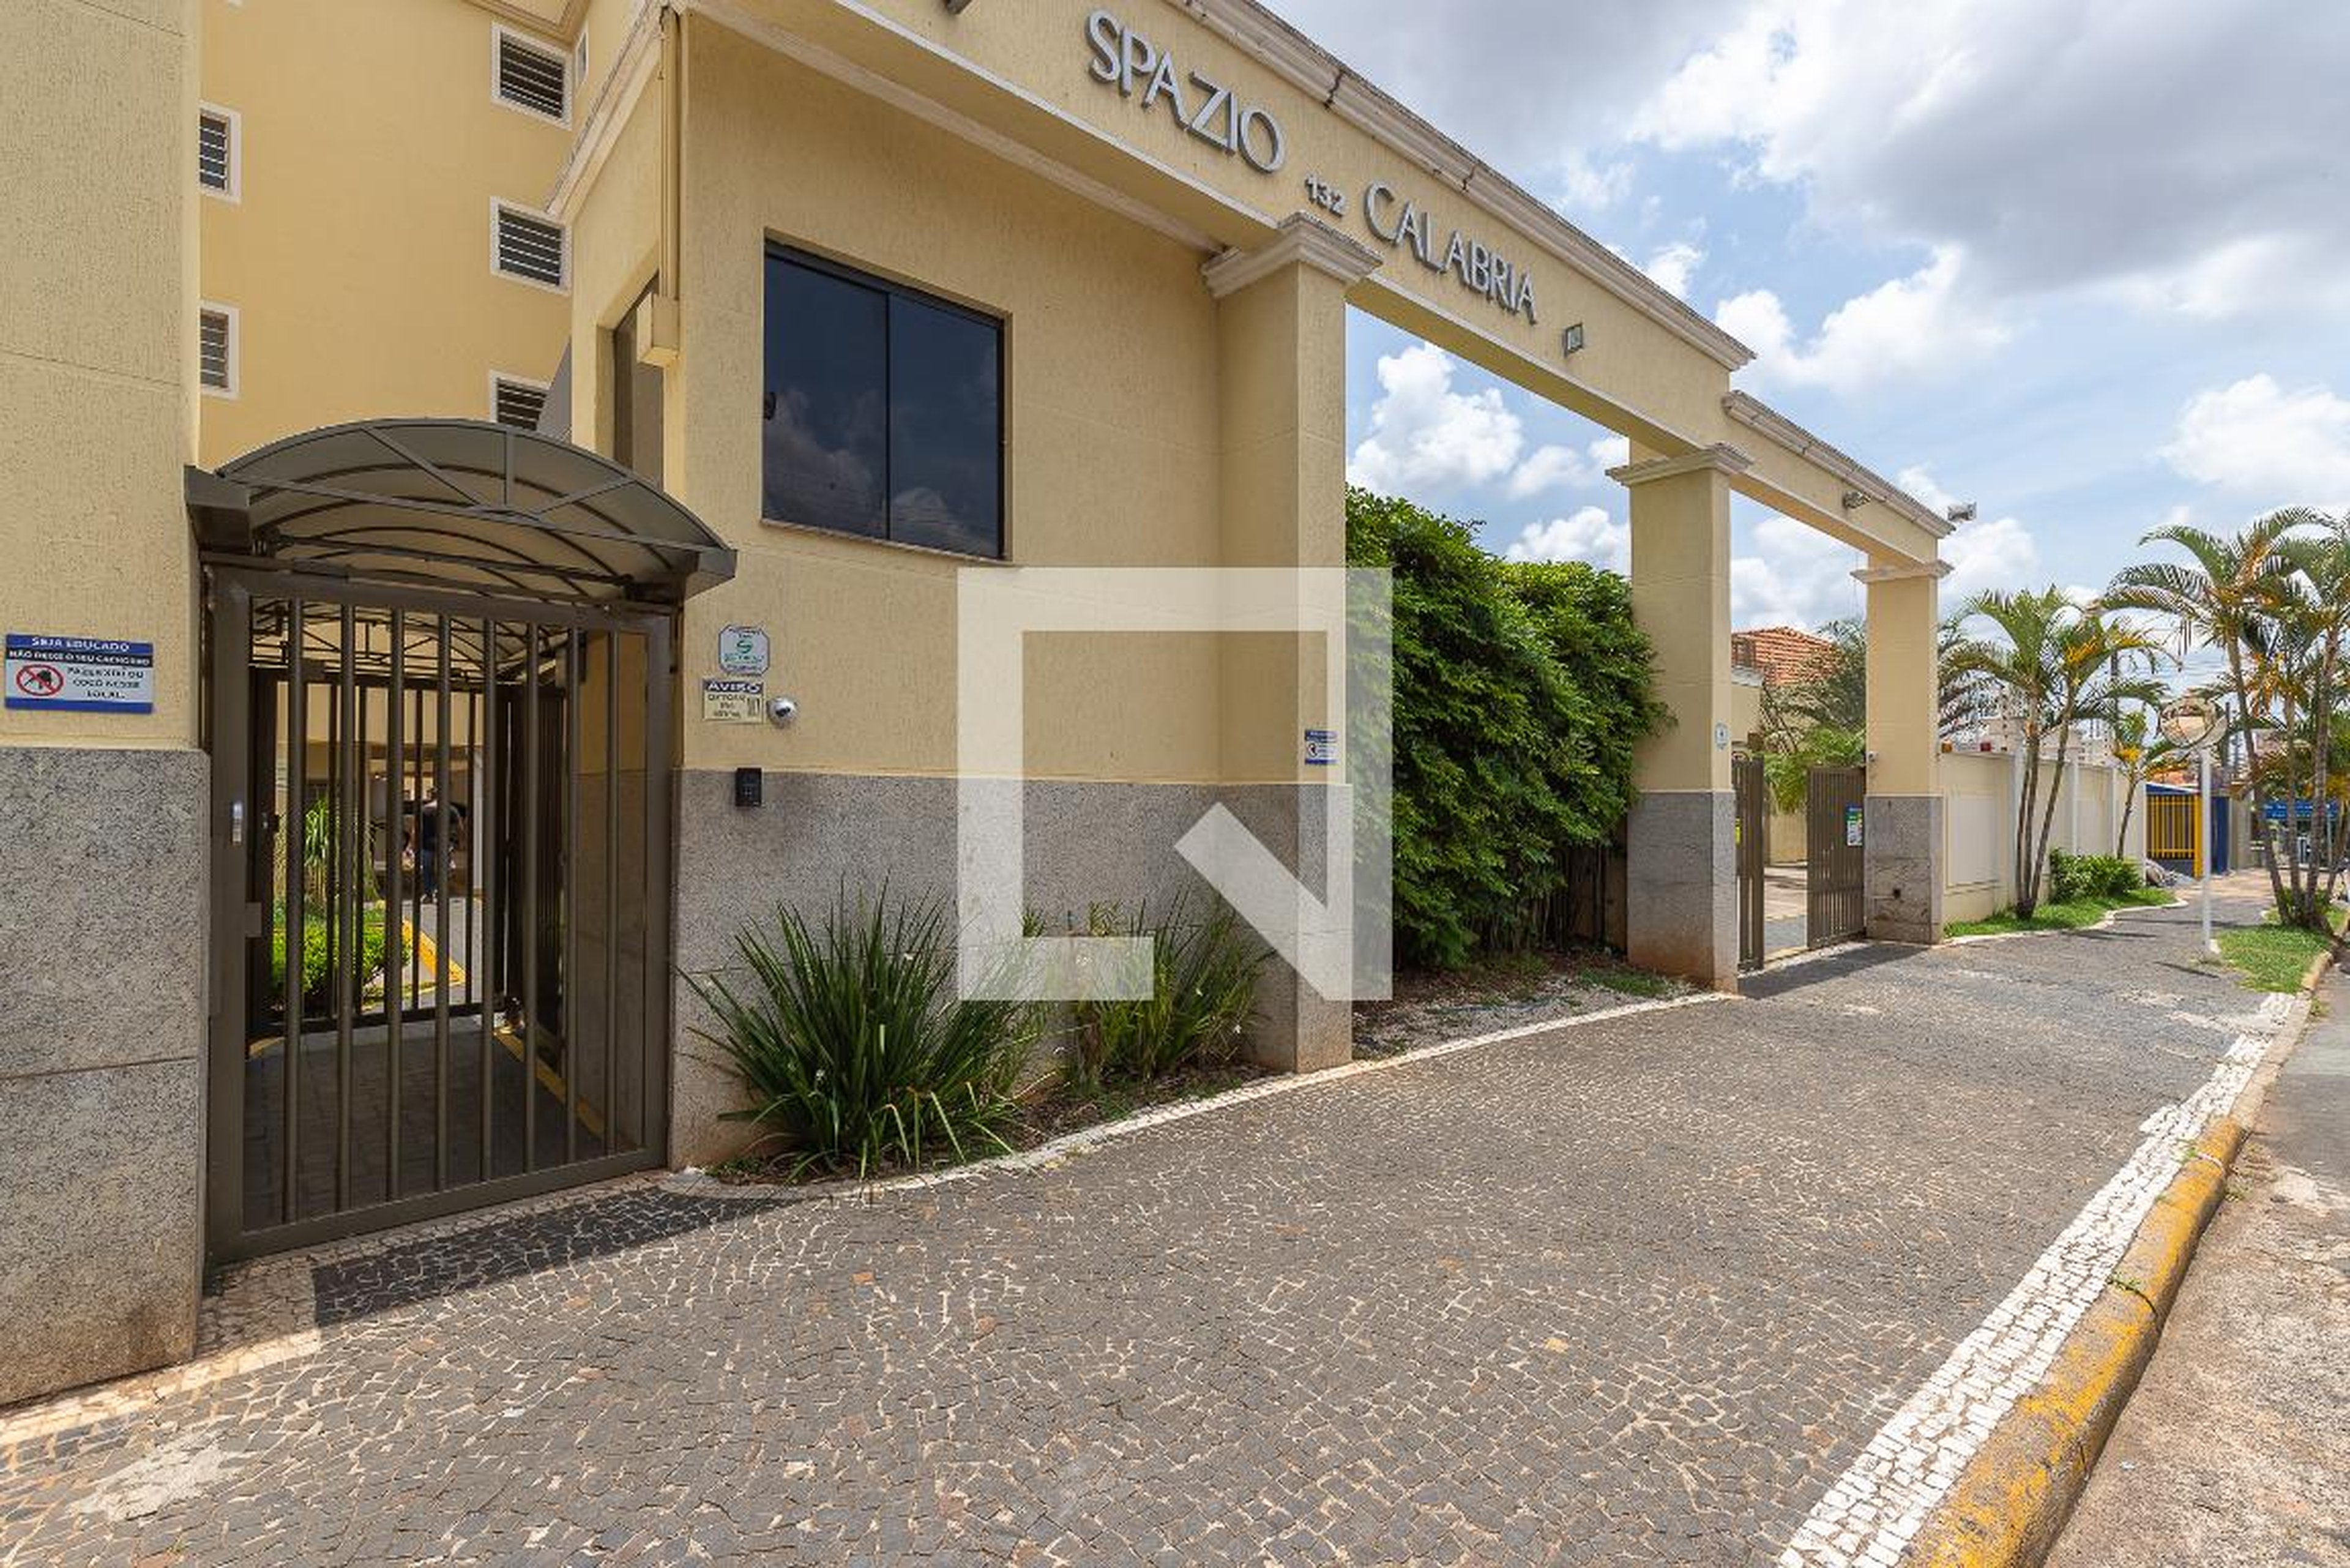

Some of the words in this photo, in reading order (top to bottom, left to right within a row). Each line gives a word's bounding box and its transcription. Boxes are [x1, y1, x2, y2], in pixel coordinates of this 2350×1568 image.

[1086, 11, 1285, 174] SPAZIO
[1304, 173, 1345, 218] 132
[1364, 181, 1537, 325] CALABRIA
[32, 637, 62, 646] SEJA
[66, 640, 130, 652] EDUCADO
